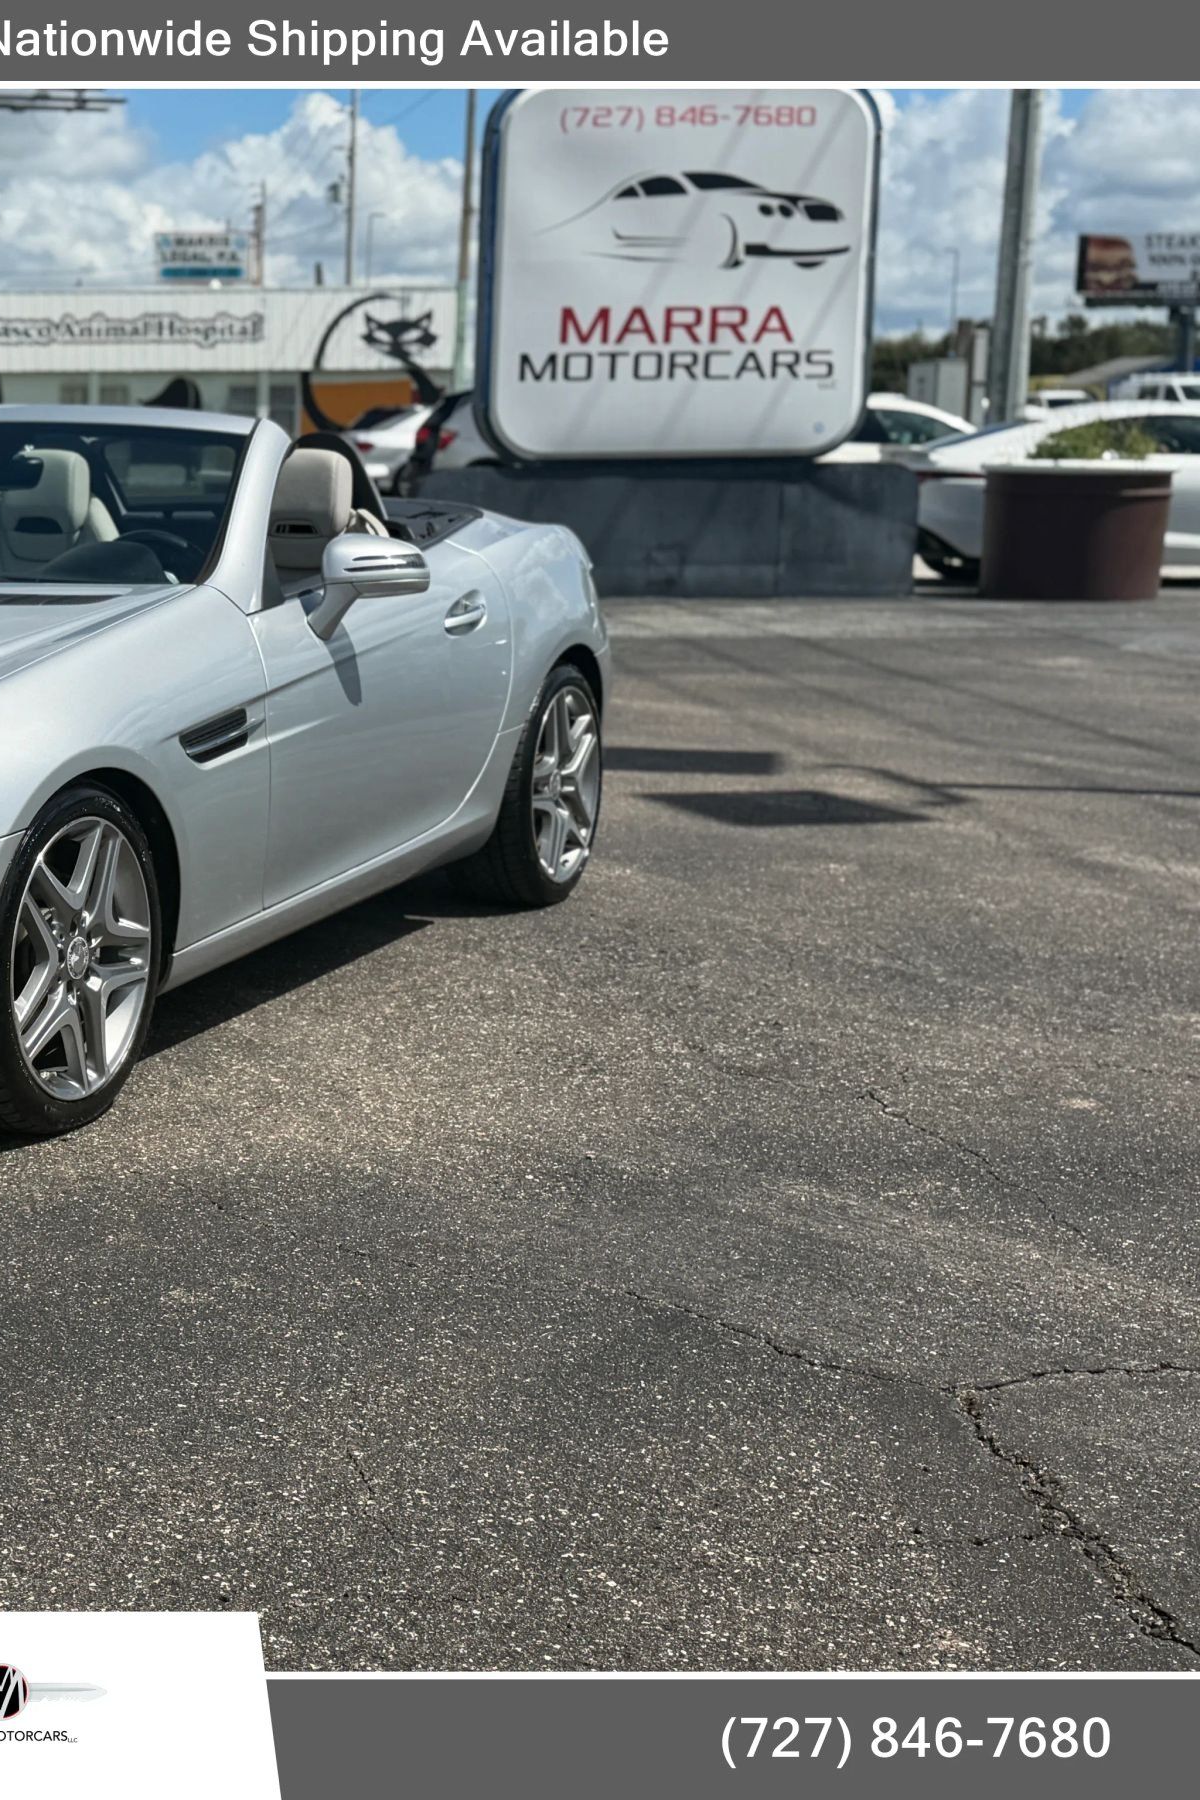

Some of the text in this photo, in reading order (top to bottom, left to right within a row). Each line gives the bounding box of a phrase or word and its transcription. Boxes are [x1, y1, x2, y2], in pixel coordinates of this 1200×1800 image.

[560, 104, 816, 134] (727) 846-7680
[59, 316, 149, 340] Animal
[155, 316, 262, 343] Hospital
[559, 306, 793, 344] MARRA
[518, 349, 834, 382] MOTORCARS
